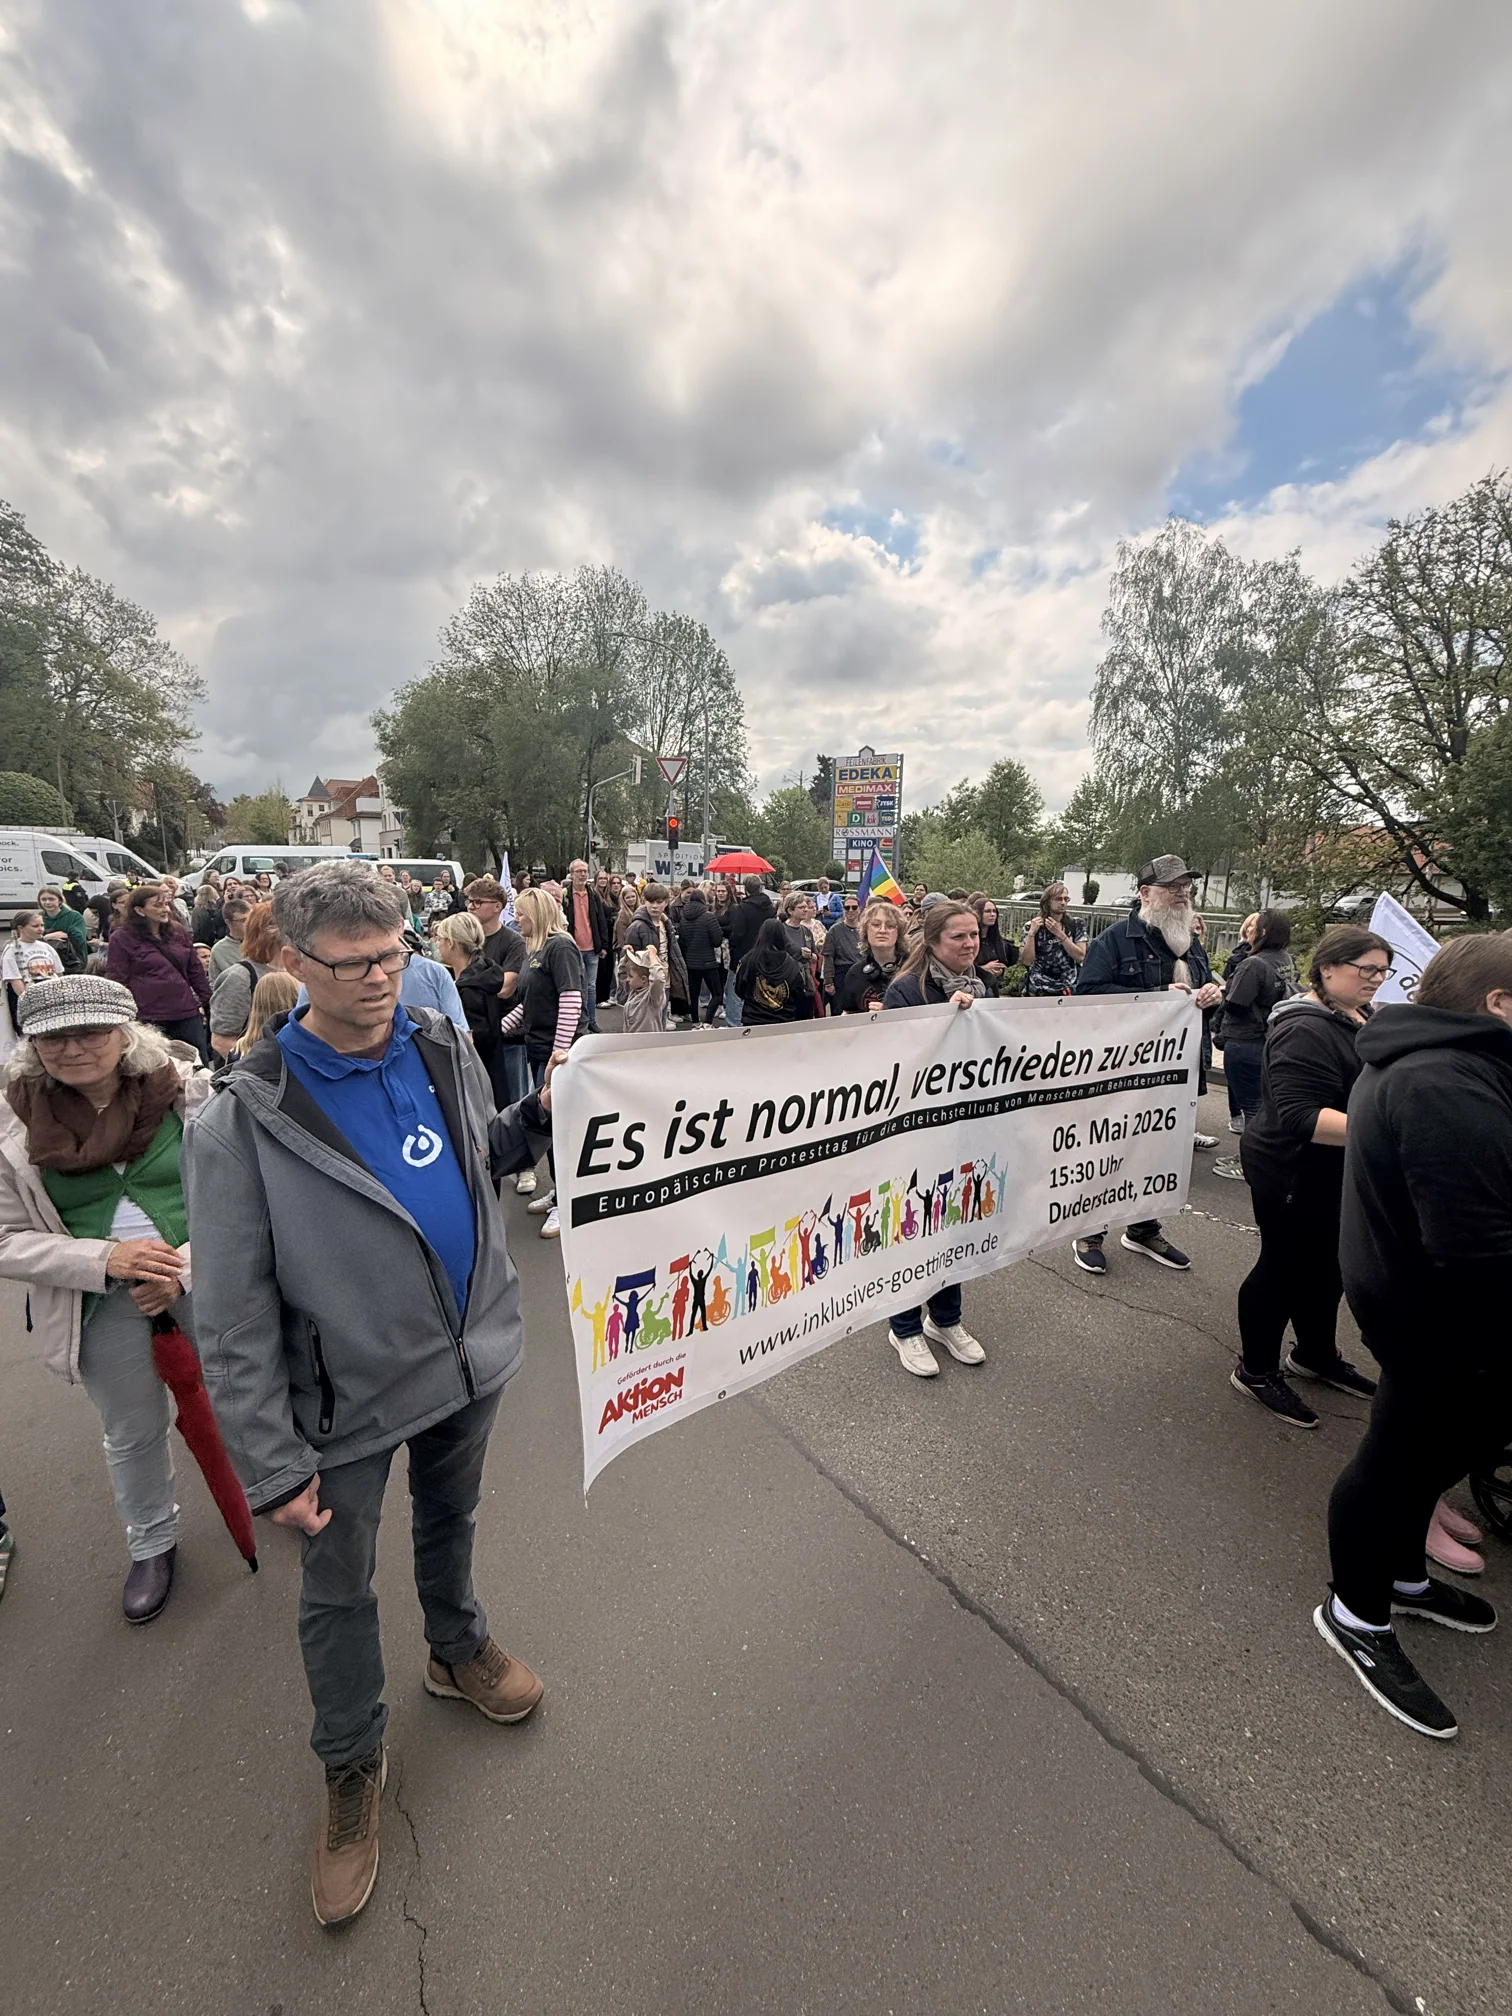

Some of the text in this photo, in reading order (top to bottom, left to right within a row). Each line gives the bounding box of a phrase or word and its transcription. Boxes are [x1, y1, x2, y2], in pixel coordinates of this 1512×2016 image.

[839, 767, 893, 780] EDEKA
[839, 784, 893, 793] MEDIMAX
[836, 828, 892, 837] ROSSMANN
[658, 852, 704, 860] SPDITION
[576, 1027, 1188, 1178] Es ist normal, verschieden zu sein!
[598, 1072, 1179, 1213] Europäischer Protesttag für die Gleichstellung von Menschen mit Behinderungen
[1052, 1107, 1177, 1152] 06. Mai 2026
[1049, 1154, 1124, 1189] 15:30 Uhr
[1049, 1172, 1178, 1224] Duderstadt, ZOB
[739, 1232, 999, 1365] www.inklusives-goettingen.de
[617, 1352, 687, 1385] Gefördert durch die
[631, 1390, 683, 1424] MENSCH
